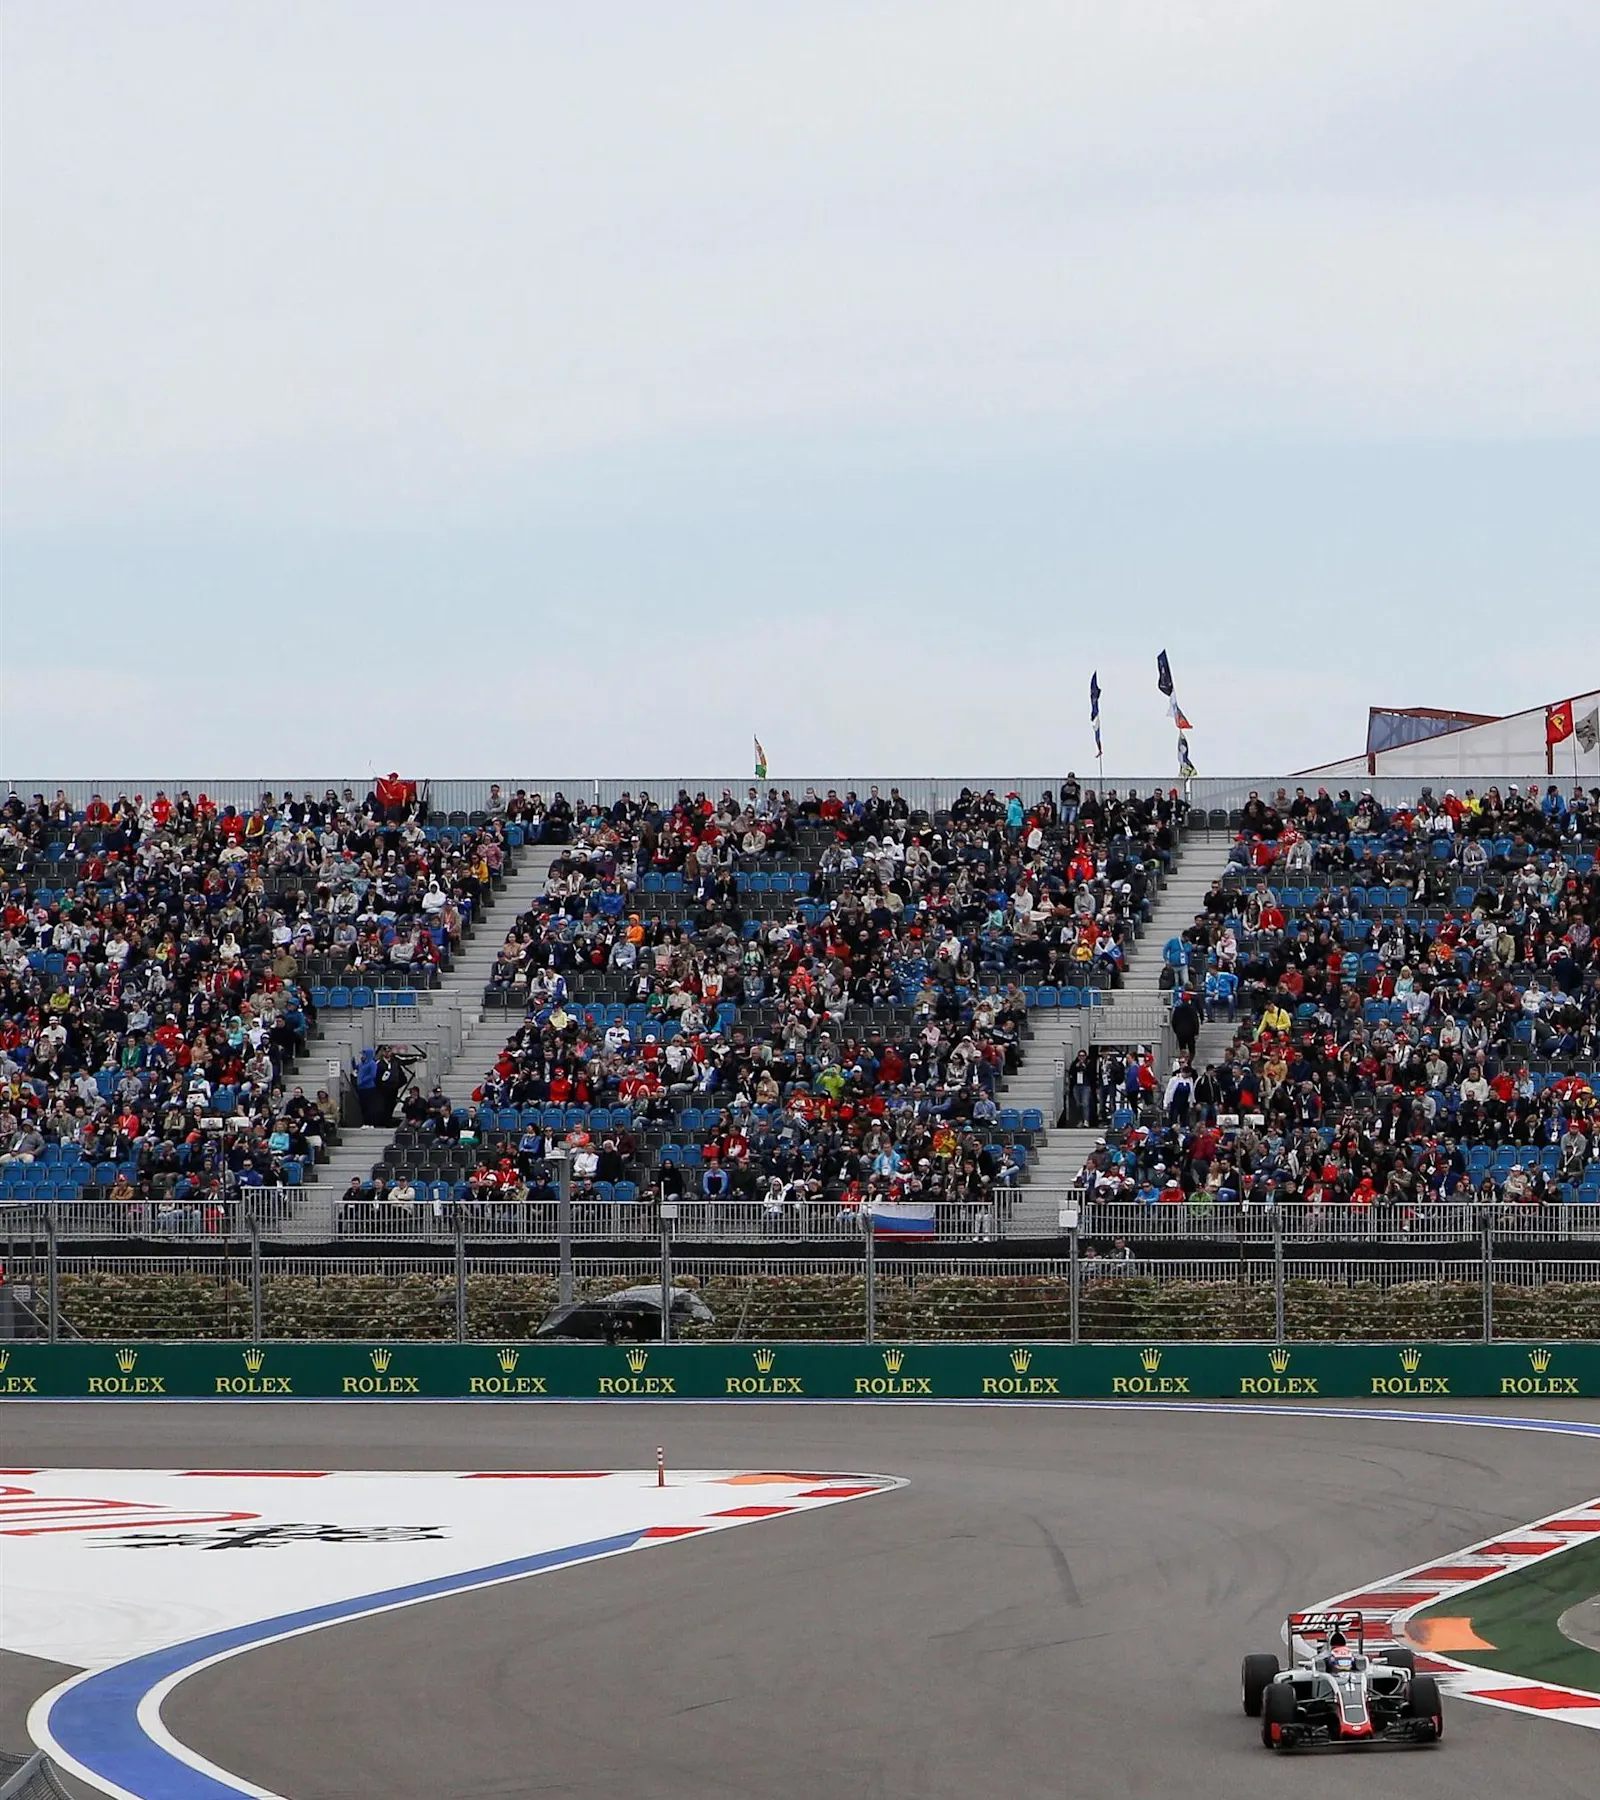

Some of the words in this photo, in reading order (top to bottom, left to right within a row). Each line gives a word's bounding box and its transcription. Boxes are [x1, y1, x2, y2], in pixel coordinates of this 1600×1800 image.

[89, 1378, 165, 1392] ROLEX
[216, 1378, 292, 1392] ROLEX
[343, 1377, 418, 1392] ROLEX
[470, 1378, 546, 1392] ROLEX
[599, 1378, 675, 1393] ROLEX
[727, 1378, 802, 1392] ROLEX
[856, 1378, 932, 1393] ROLEX
[983, 1378, 1059, 1393] ROLEX
[1113, 1377, 1189, 1392] ROLEX
[1241, 1378, 1318, 1393] ROLEX
[1372, 1378, 1449, 1393] ROLEX
[1501, 1378, 1579, 1393] ROLEX
